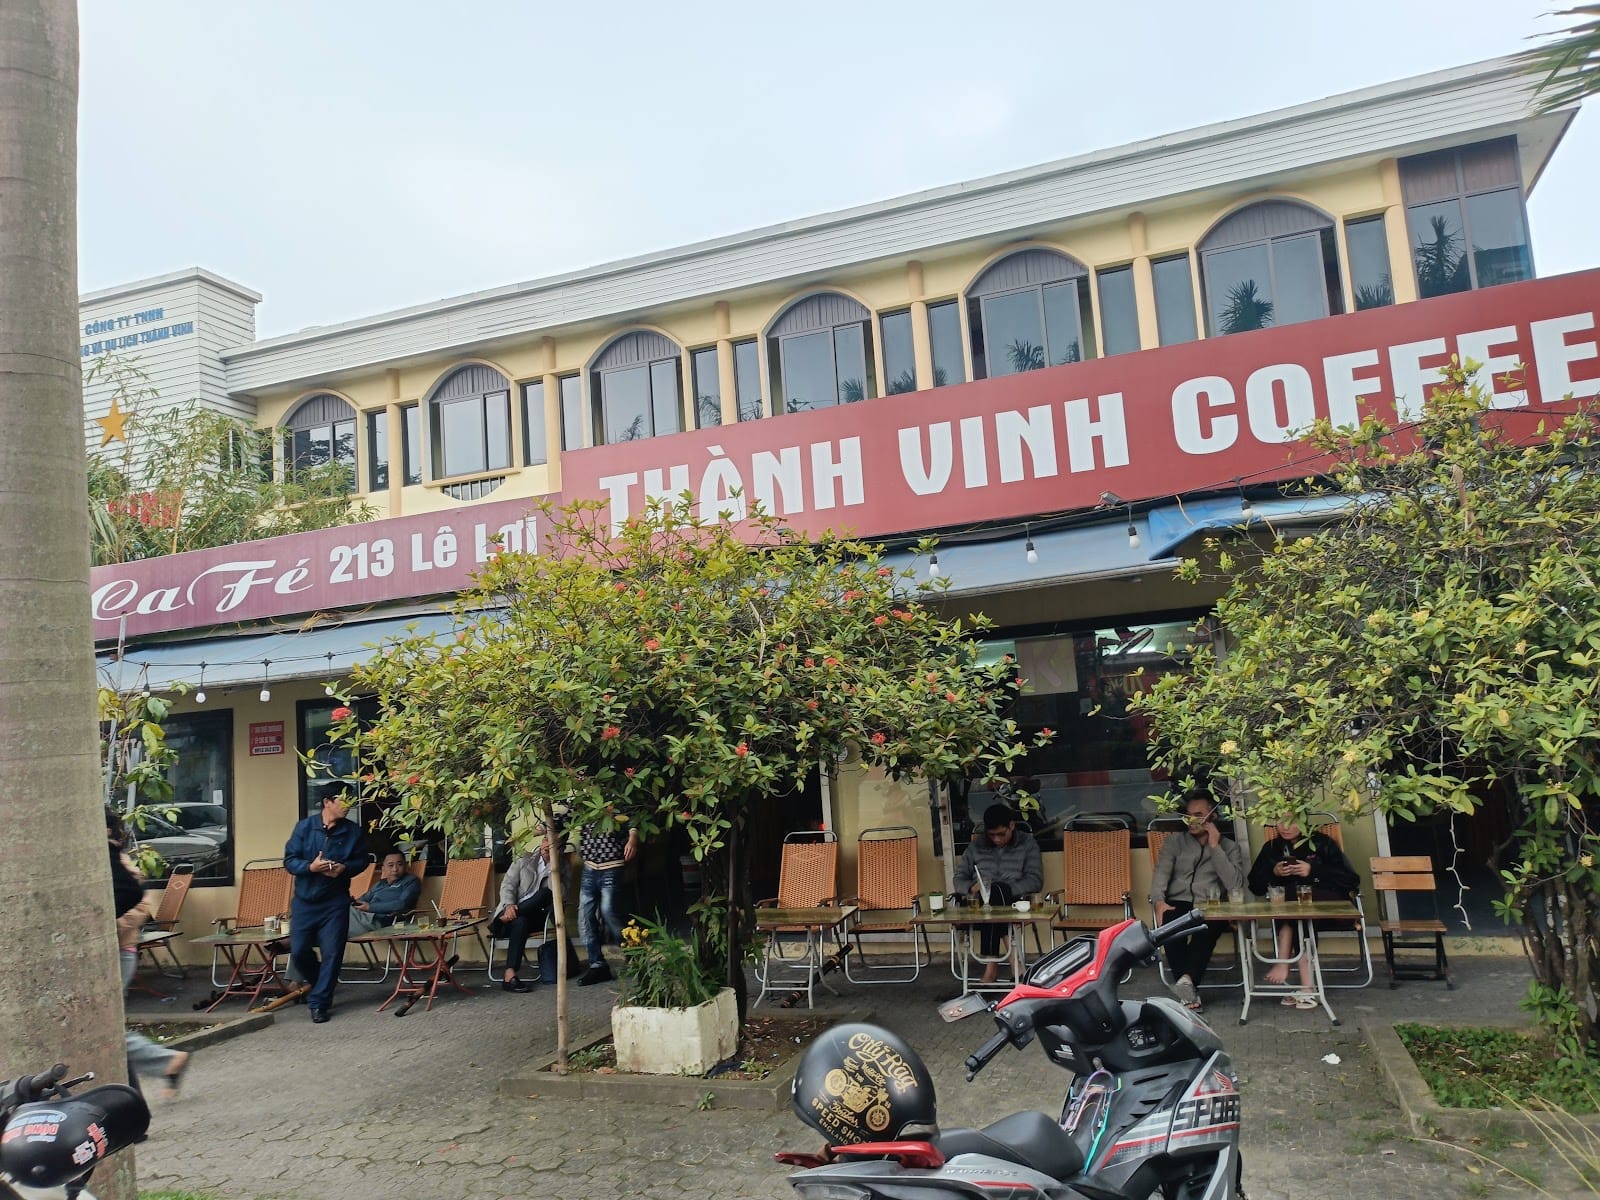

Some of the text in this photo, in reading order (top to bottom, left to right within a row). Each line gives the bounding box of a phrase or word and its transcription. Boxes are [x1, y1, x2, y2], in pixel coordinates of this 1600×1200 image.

[117, 315, 131, 328] TY
[599, 312, 1600, 539] THÀNH VINH COFFEE
[329, 538, 395, 584] 213
[411, 525, 458, 572] Lê
[811, 1097, 840, 1128] SPEED
[819, 1118, 849, 1145] ENGLAND
